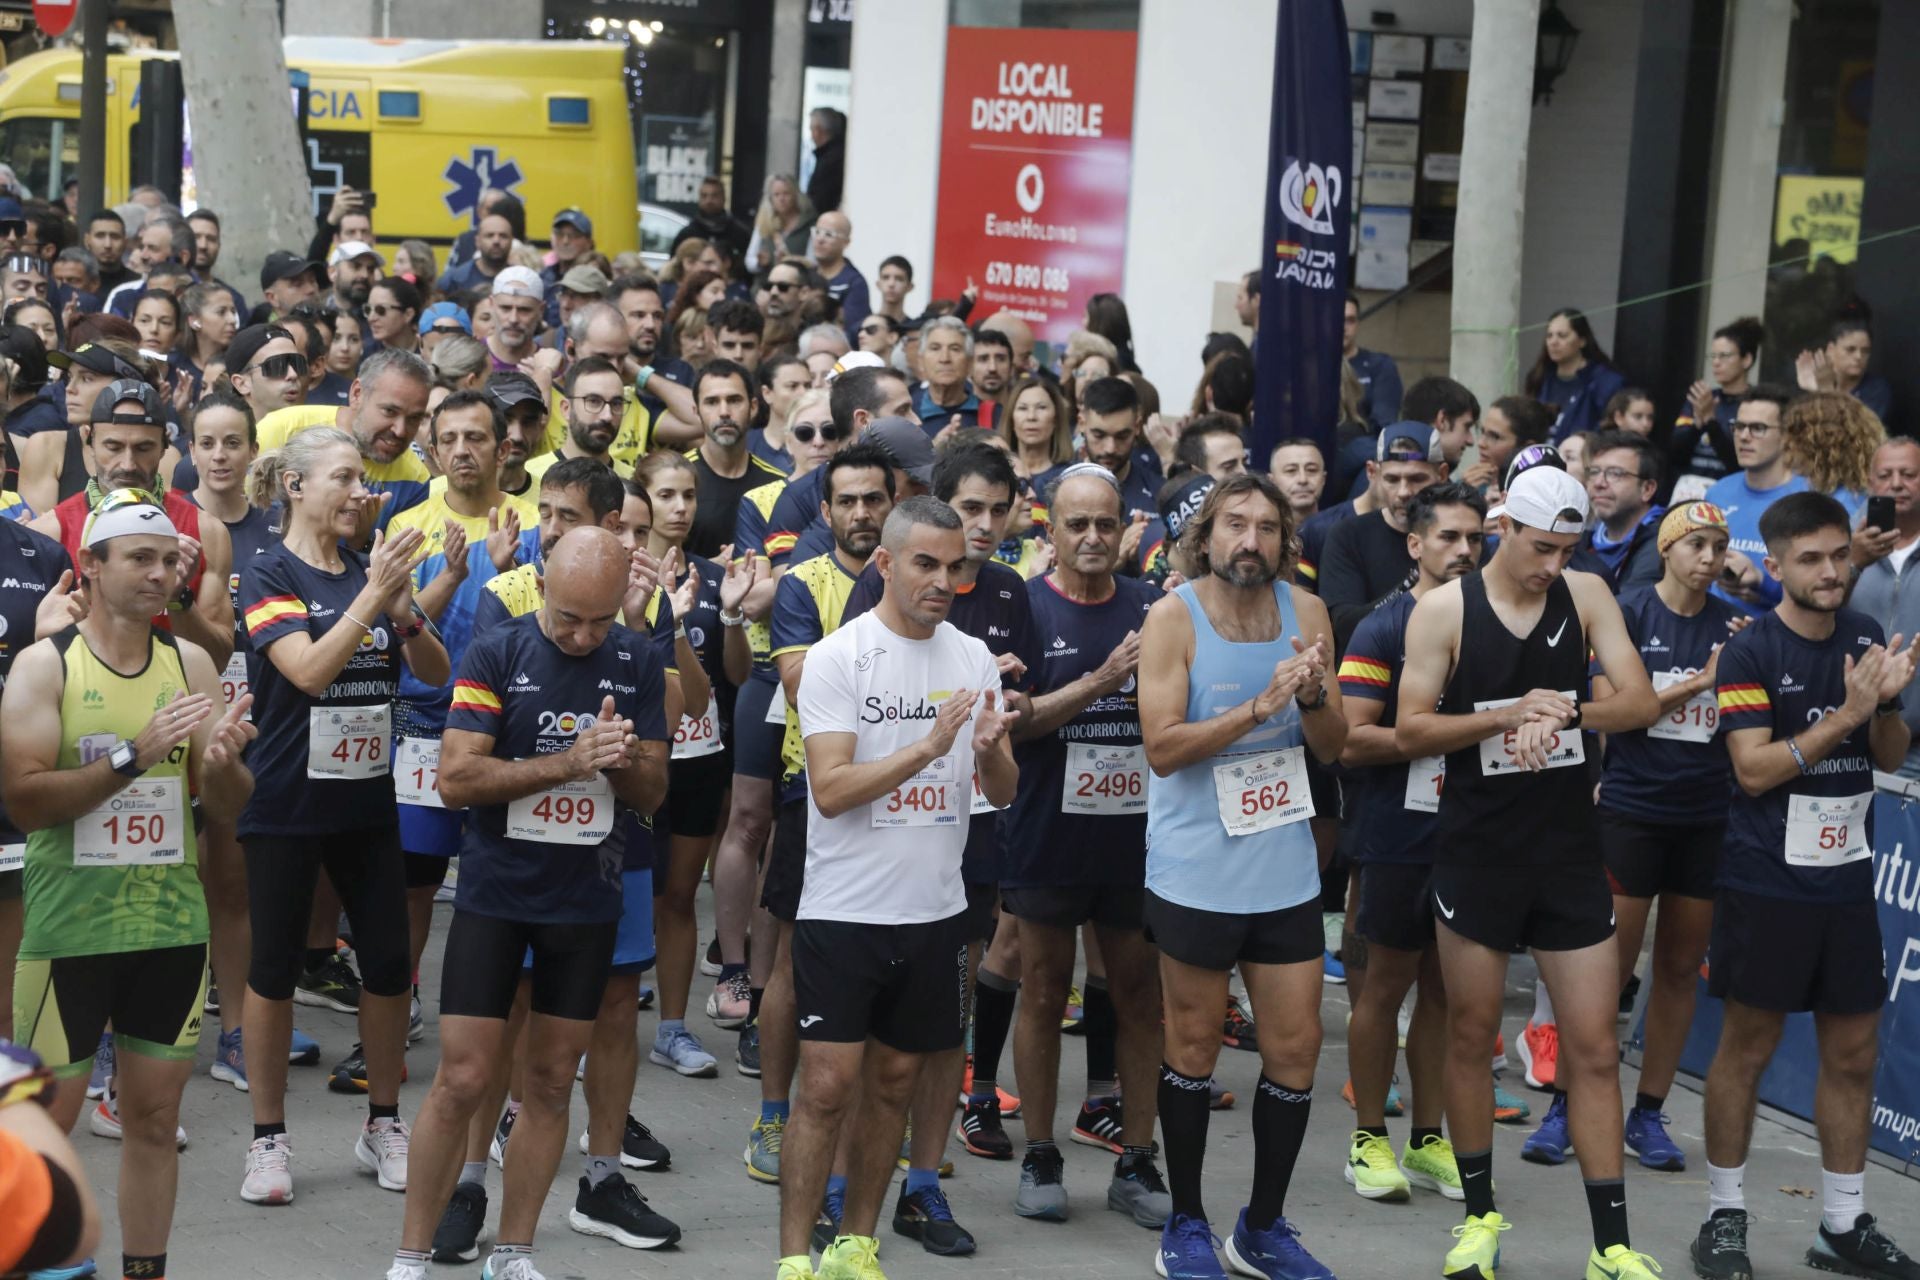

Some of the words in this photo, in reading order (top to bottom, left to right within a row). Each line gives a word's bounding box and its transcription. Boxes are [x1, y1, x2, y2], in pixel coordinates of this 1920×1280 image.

[998, 61, 1072, 98] LOCAL
[971, 97, 1104, 138] DISPONIBLE
[1044, 647, 1079, 658] Santander
[331, 736, 382, 763] 478
[887, 785, 946, 813] 3401
[1077, 771, 1142, 798] 2496
[1241, 780, 1290, 816] 562
[532, 795, 595, 825] 499
[103, 814, 165, 845] 150
[1818, 824, 1848, 850] 59
